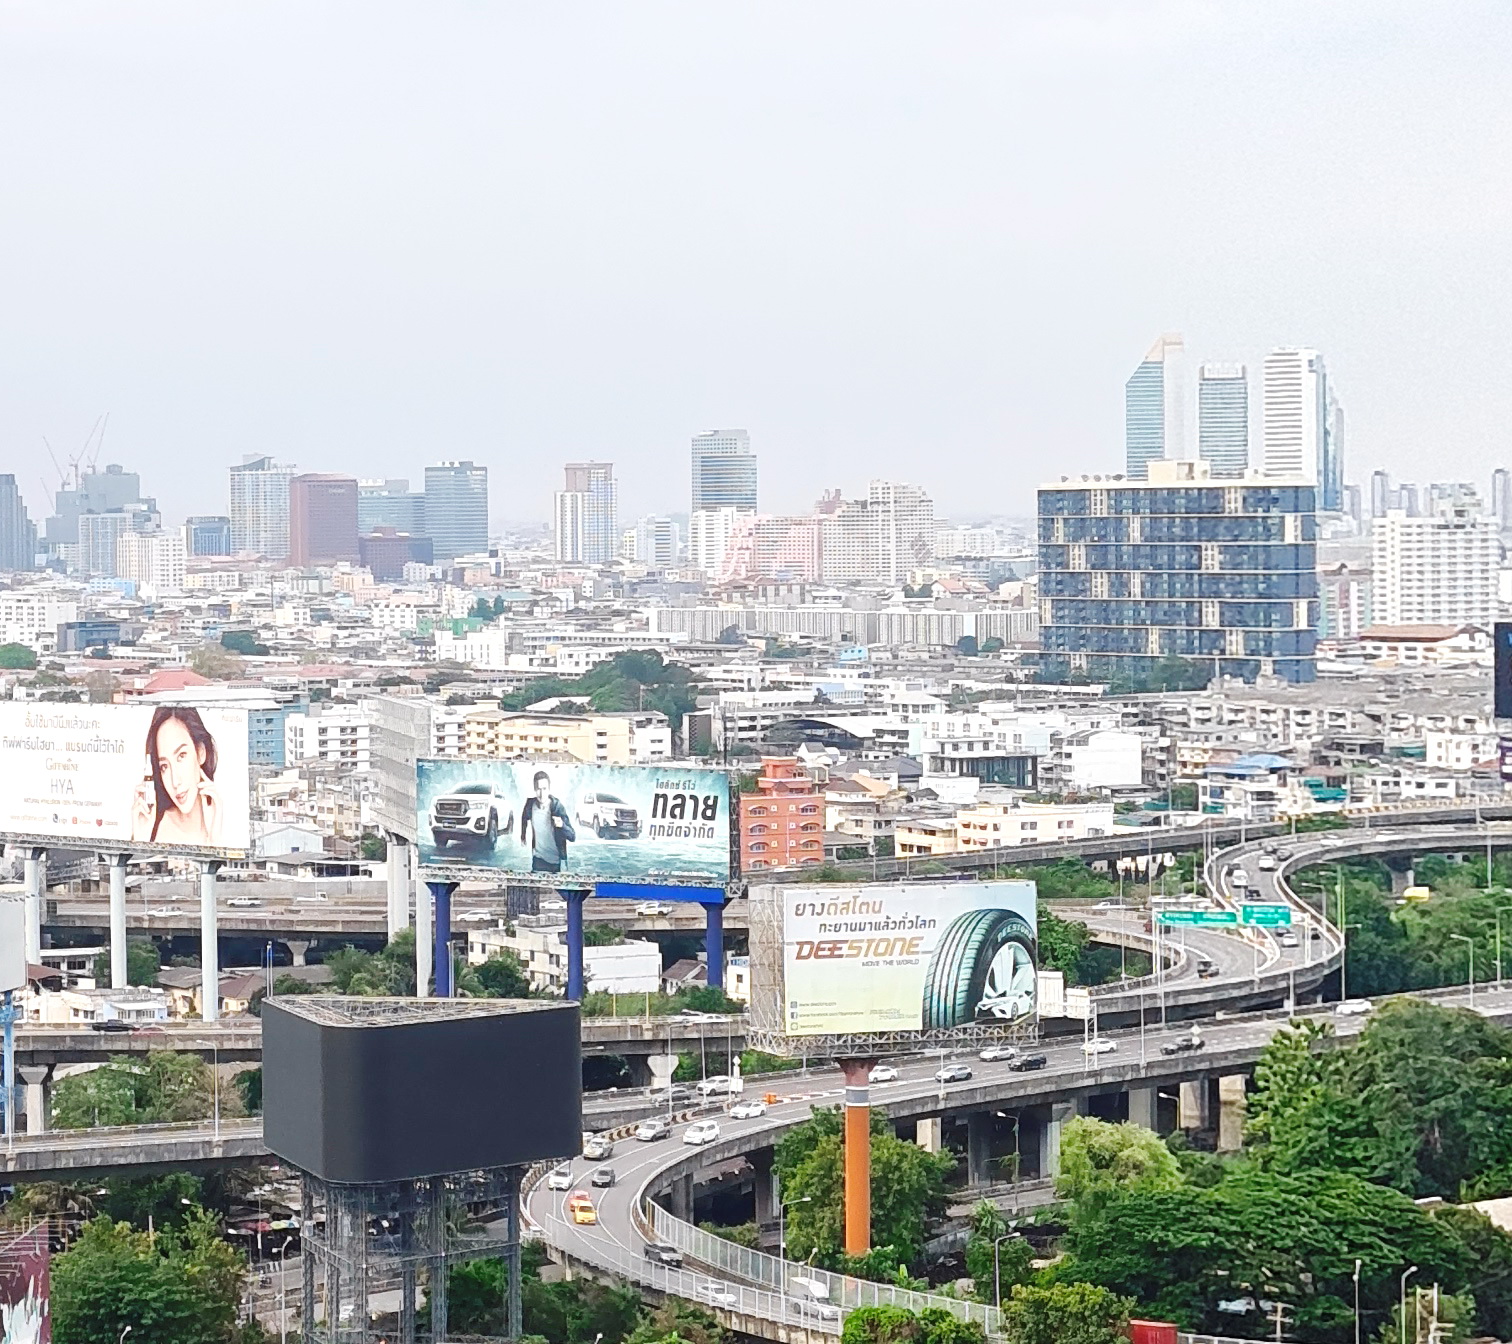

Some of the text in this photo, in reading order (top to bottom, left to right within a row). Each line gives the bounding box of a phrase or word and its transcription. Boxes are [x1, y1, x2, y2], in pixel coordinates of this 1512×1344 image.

[50, 778, 75, 795] HYA
[651, 793, 719, 821] ทลาย
[649, 821, 715, 841] ทุกขีดจำกัด
[794, 896, 883, 917] ยางดีสโตน
[819, 912, 937, 934] ทะยานมาแล้วทั่วโลก
[795, 936, 925, 961] DEESTONE
[895, 958, 920, 967] WORLD
